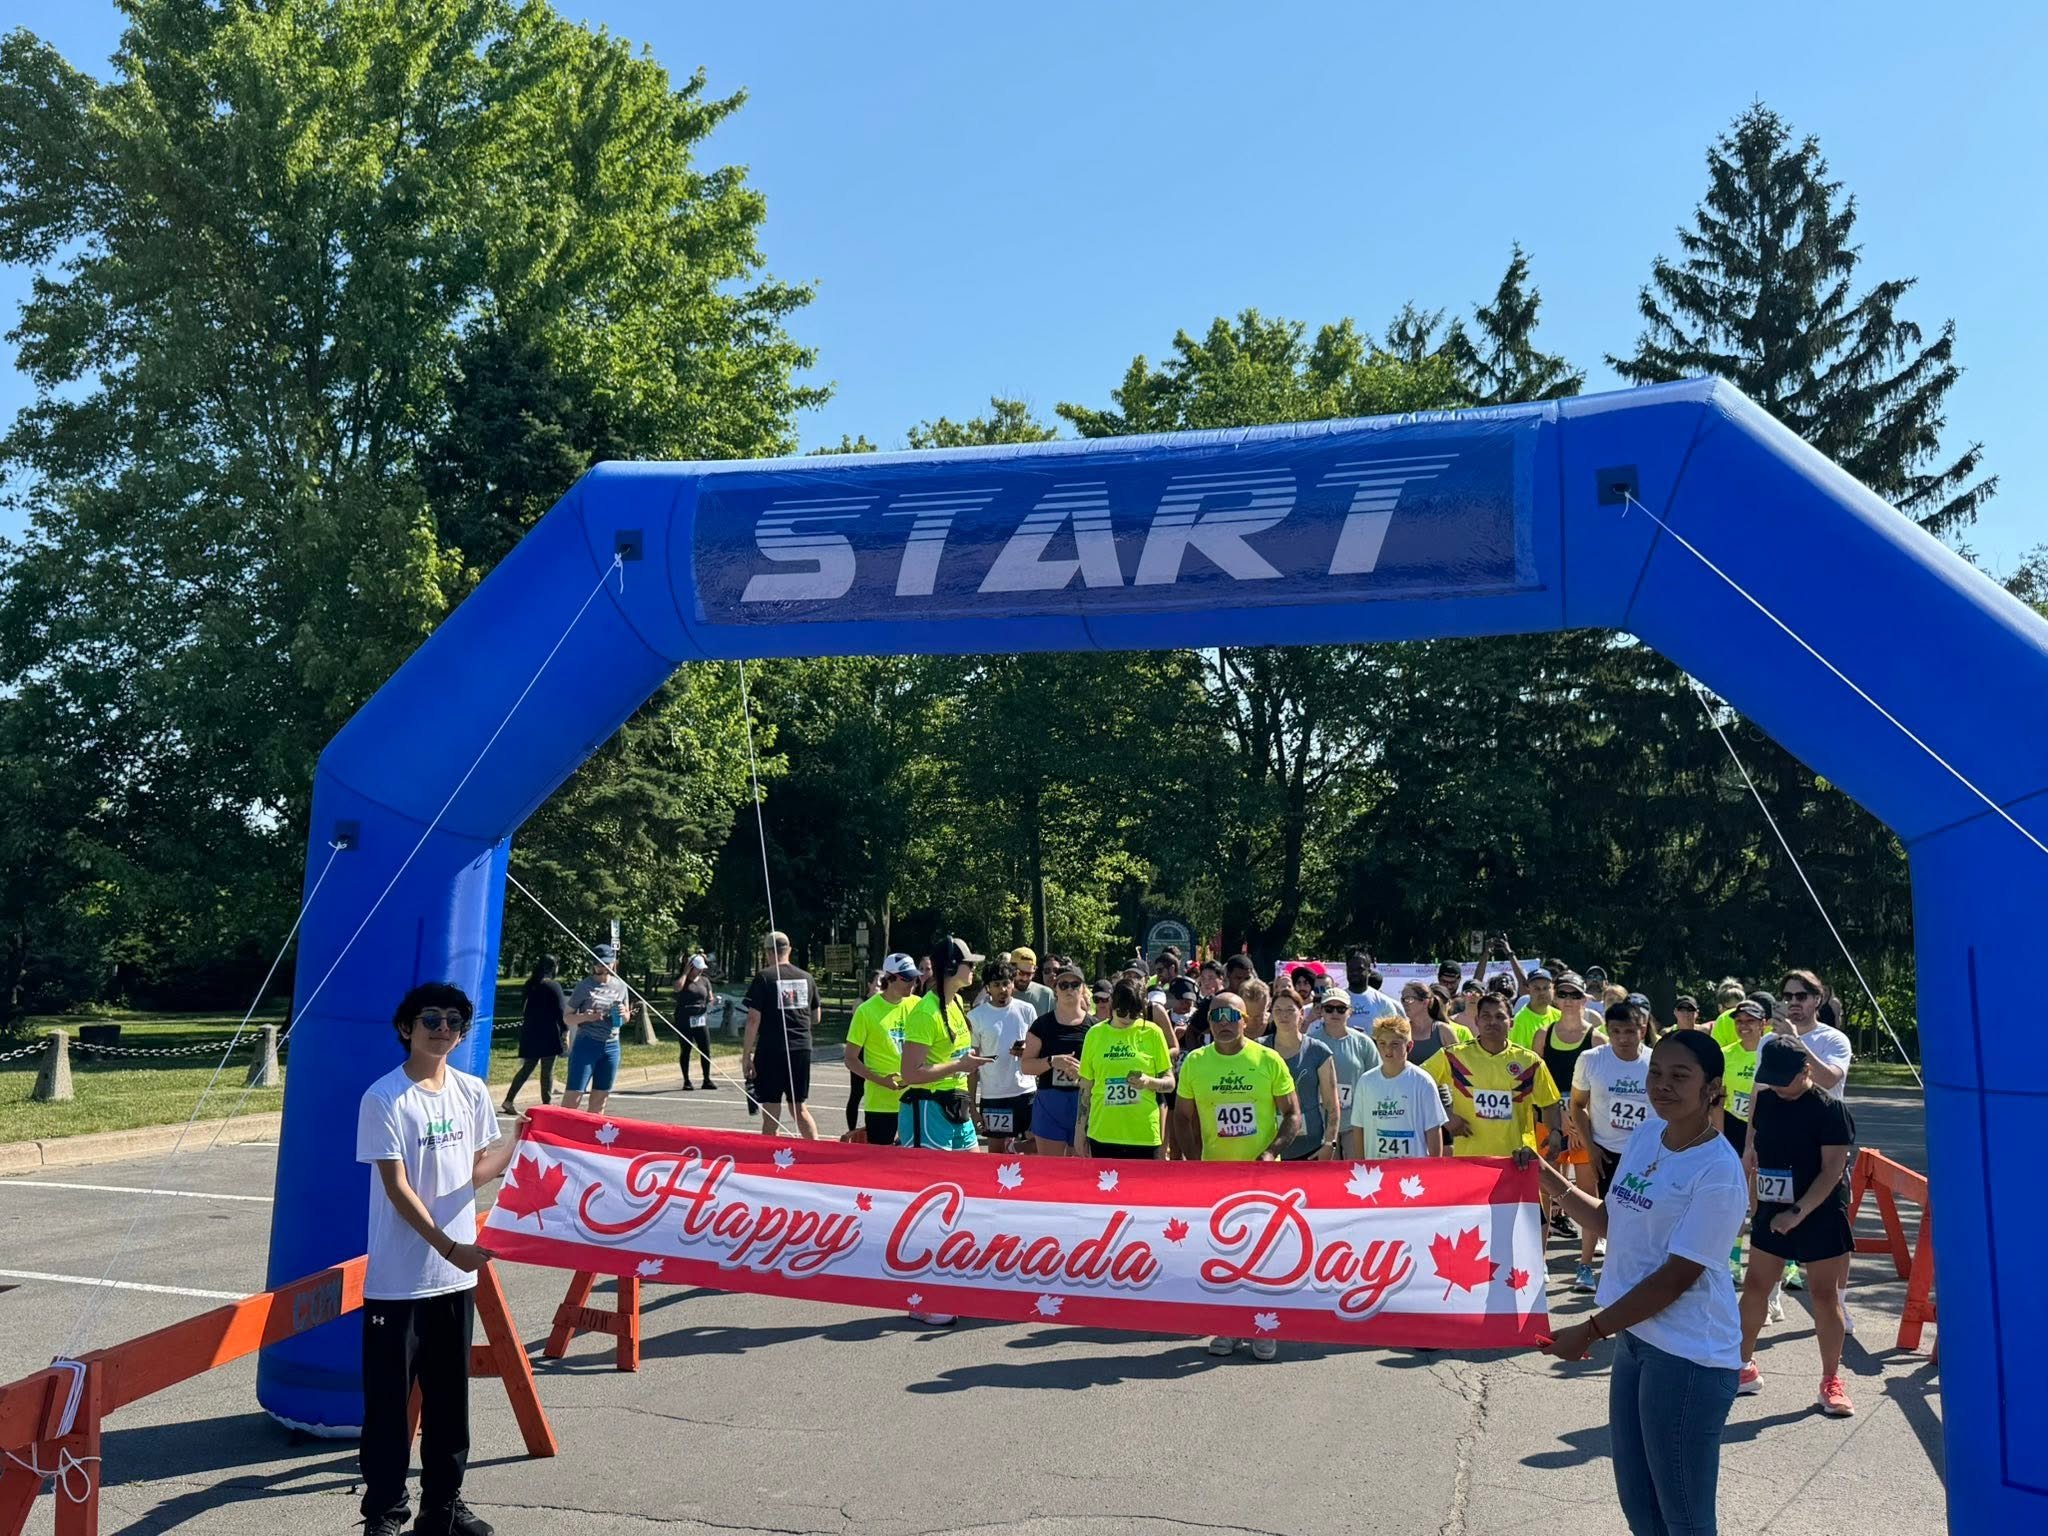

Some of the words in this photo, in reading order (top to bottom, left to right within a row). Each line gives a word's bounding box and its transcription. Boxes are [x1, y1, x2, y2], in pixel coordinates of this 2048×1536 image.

[741, 453, 1460, 602] START
[1107, 1085, 1137, 1100] 236
[1475, 1093, 1510, 1109] 404
[1611, 1102, 1646, 1121] 424
[1735, 1098, 1750, 1113] 12
[985, 1114, 1009, 1128] 172
[1217, 1106, 1253, 1125] 405
[1378, 1137, 1409, 1154] 241
[1758, 1176, 1786, 1197] 027
[576, 1146, 863, 1276] Happy
[884, 1182, 1160, 1284] Canada
[1198, 1188, 1415, 1319] Day
